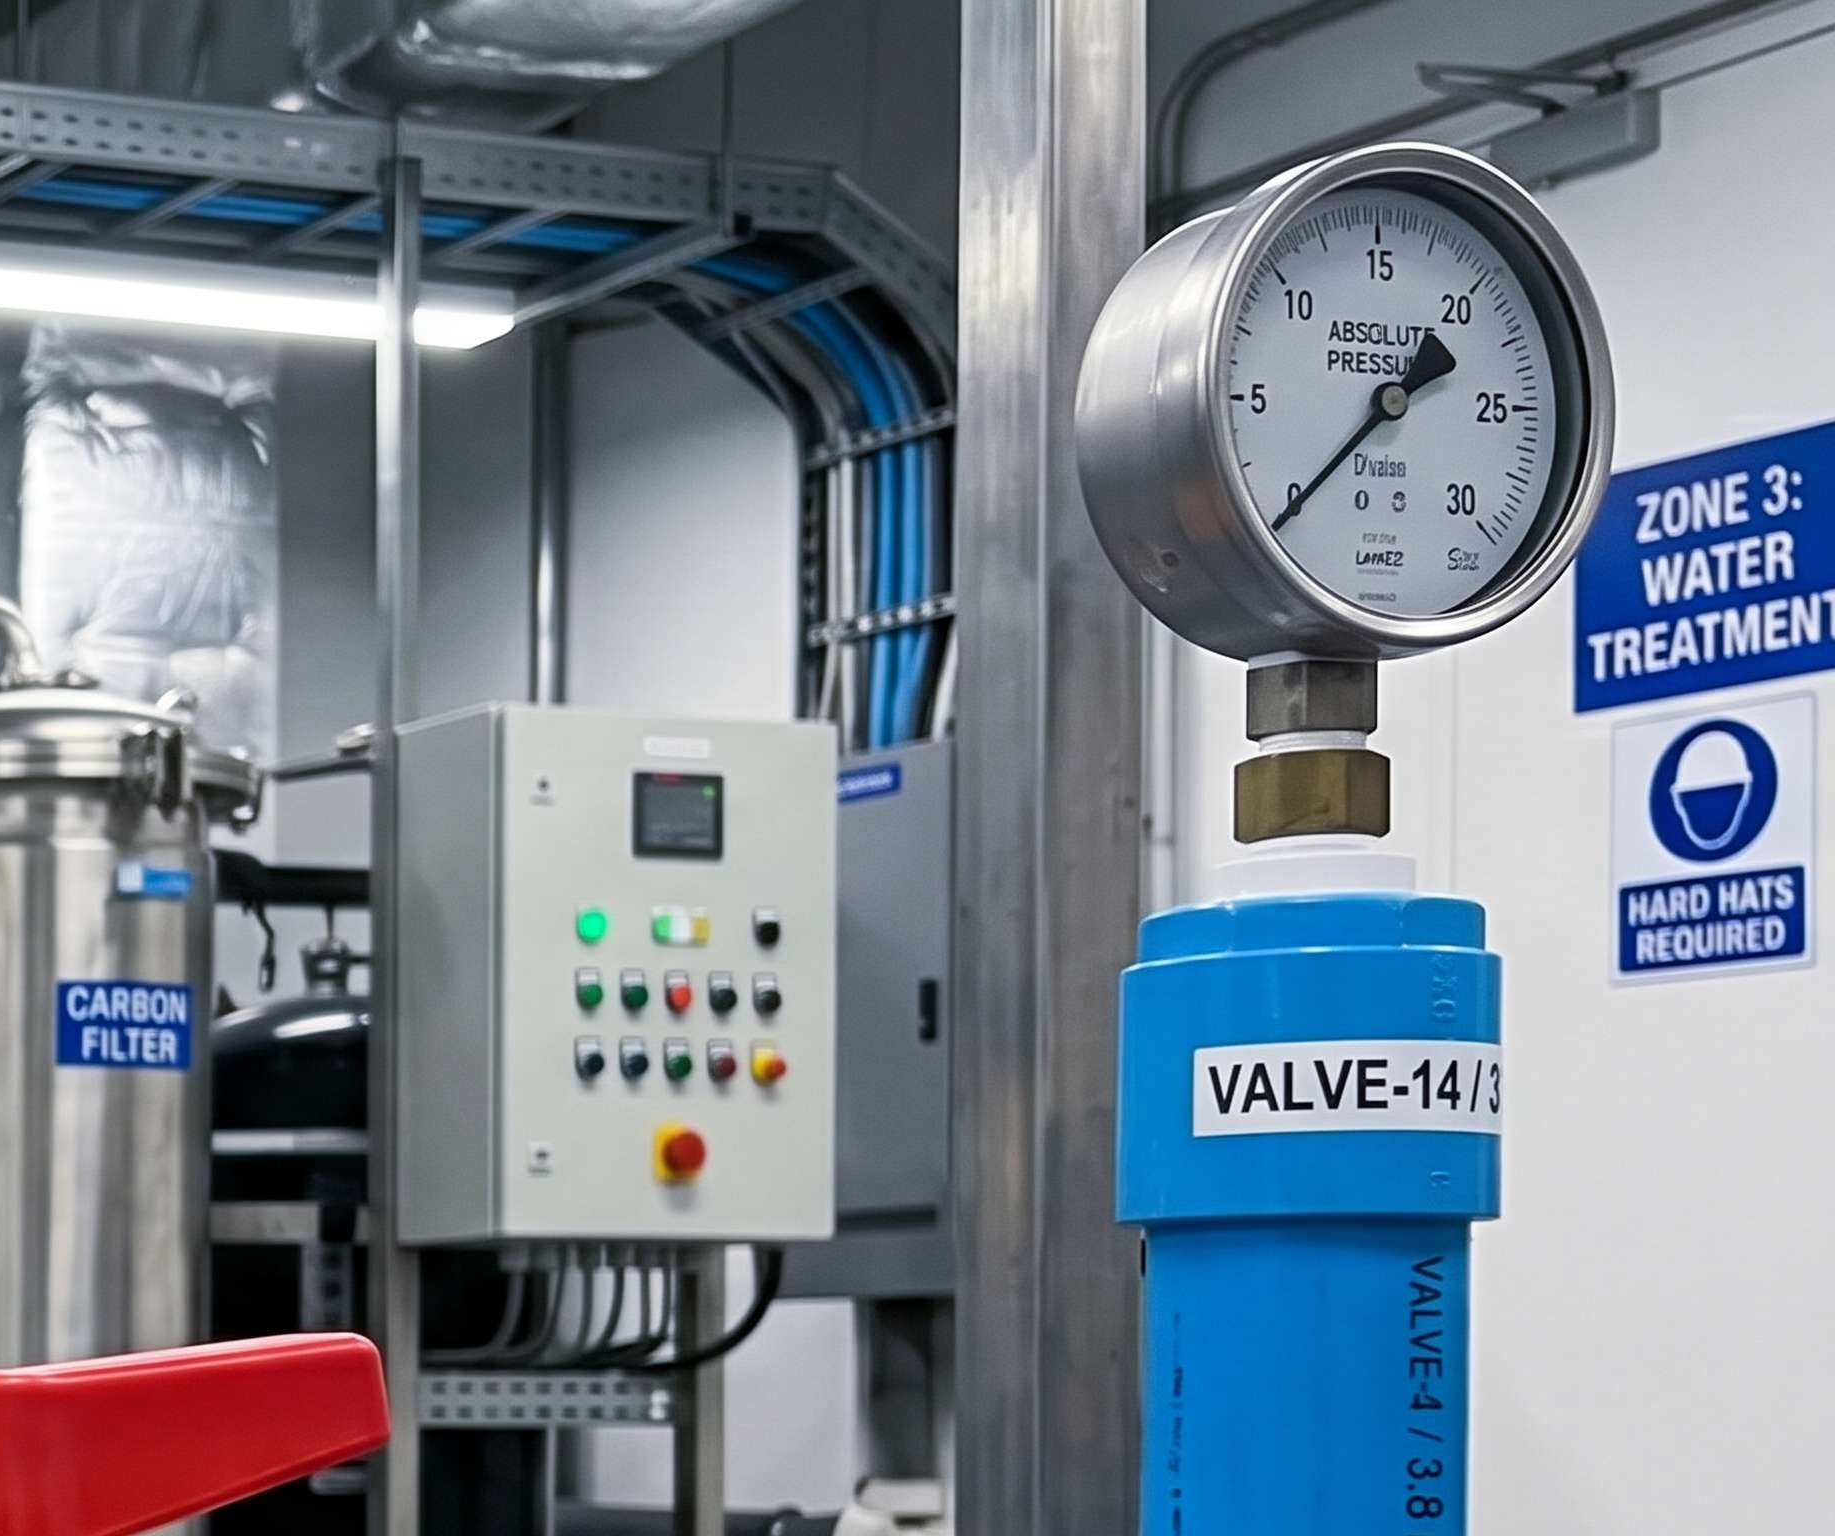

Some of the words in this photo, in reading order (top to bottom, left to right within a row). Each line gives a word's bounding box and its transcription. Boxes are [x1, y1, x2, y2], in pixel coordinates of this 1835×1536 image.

[1366, 250, 1393, 281] 15
[1284, 290, 1313, 320] 10
[1441, 294, 1471, 325] 20
[1251, 384, 1266, 414] 5
[1476, 392, 1507, 423] 25
[1447, 483, 1475, 515] 30
[1635, 471, 1750, 544] ZONE
[1763, 464, 1803, 516] 3:
[1642, 530, 1794, 607] WATER
[1628, 884, 1711, 927] HARD
[1719, 874, 1796, 915] HATS
[1636, 915, 1786, 964] REQUIRED
[66, 985, 187, 1025] CARBON
[82, 1025, 178, 1064] FILTER
[1208, 1059, 1462, 1114] VALVE-14
[1469, 1059, 1482, 1113] /
[1407, 1426, 1444, 1443] /
[1405, 1457, 1444, 1519] 3.8
